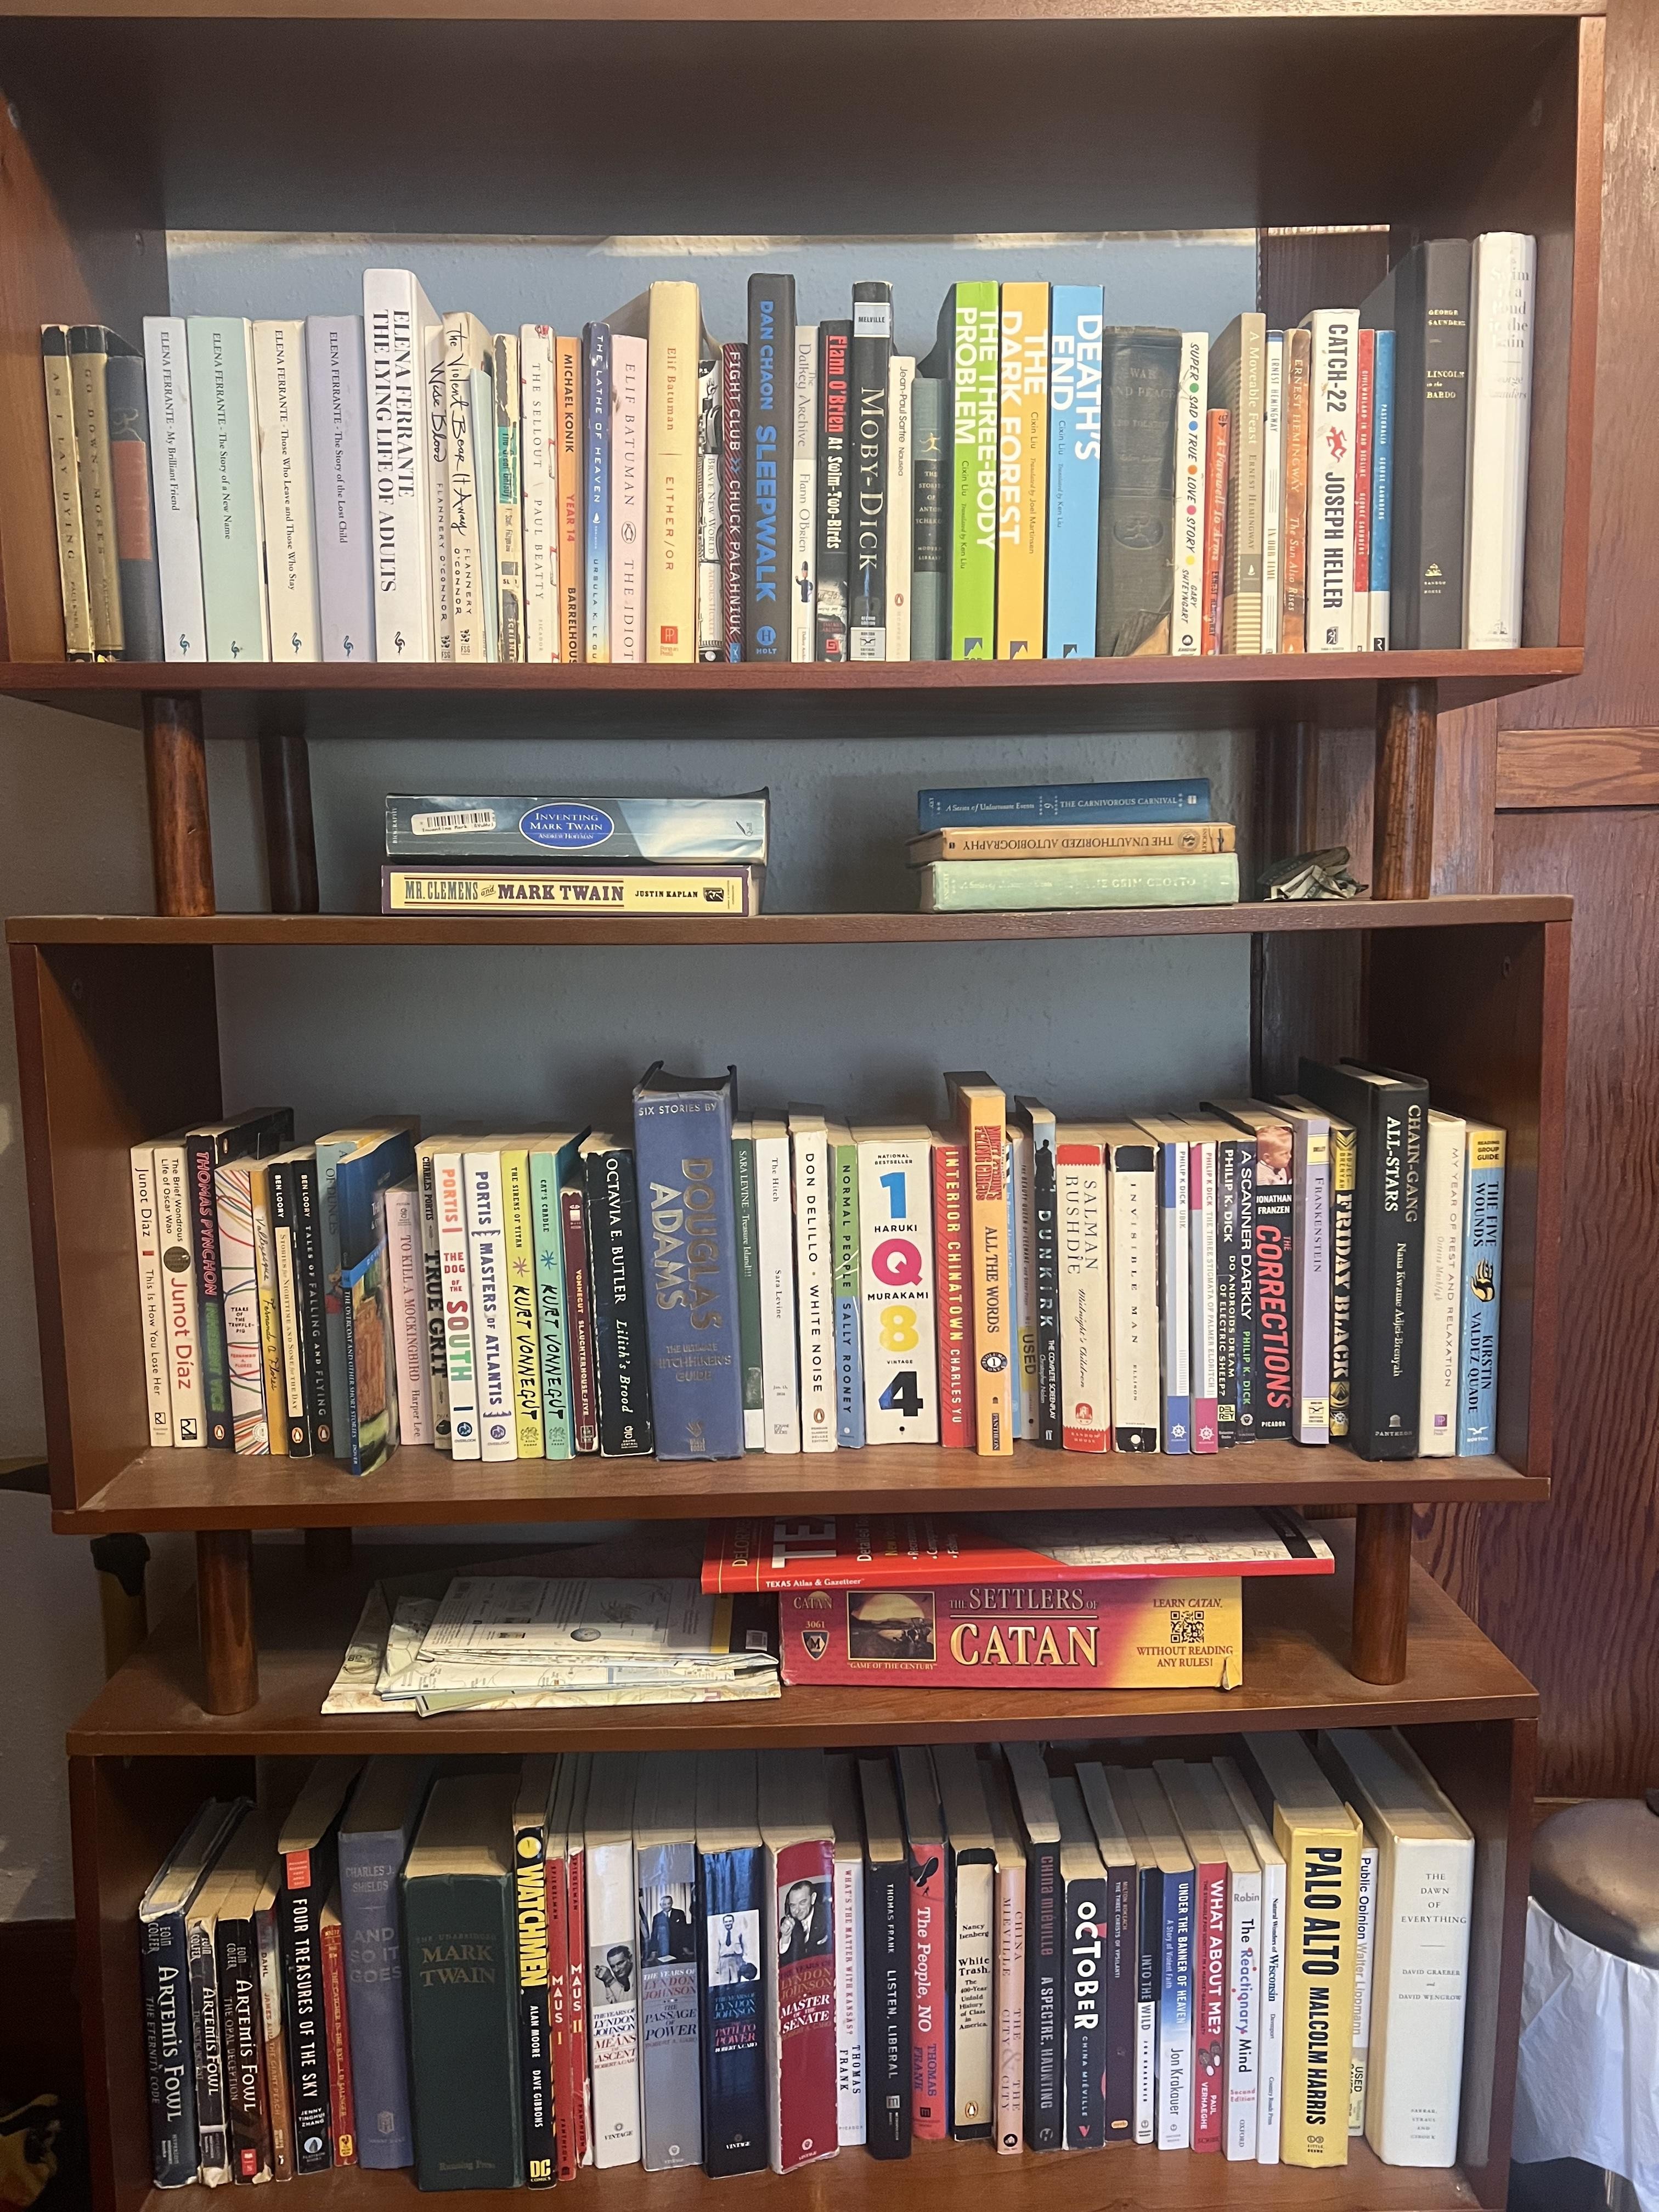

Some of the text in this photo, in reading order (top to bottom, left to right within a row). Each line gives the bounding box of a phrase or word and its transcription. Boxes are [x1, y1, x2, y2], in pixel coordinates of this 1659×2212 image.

[858, 315, 885, 324] MELVILLE
[828, 335, 848, 432] Flann O'Brien
[899, 366, 907, 413] Jean-Paul
[955, 307, 977, 444] PROBLEM
[1024, 329, 1048, 395] THE
[1051, 335, 1074, 410] END
[1075, 315, 1103, 460] DEATH'S
[161, 331, 180, 511] ELENA FERRANTE My Brilliant Friend
[394, 311, 414, 498] ELENA FERRANTE
[446, 323, 473, 537] The Violent Bear It Away
[563, 354, 574, 453] MICHAEL KONIK
[595, 423, 601, 439] OF
[899, 414, 907, 443] Sartre
[977, 309, 999, 550] THE THREE-BODY
[999, 311, 1022, 544] DARK FOREST
[373, 309, 396, 592] THE LYING LIFE OF ADULTS
[755, 301, 776, 602] DAN CHAON SLEEPWALK
[1186, 342, 1199, 554] SUPER SAD TRUE LOVE STORY
[1323, 324, 1348, 610] CATCH-22 JOSEPH HELLER
[665, 476, 674, 571] EITHER/OR
[729, 351, 741, 635] FIGHT CLUB CHUCK PALAHNIUK
[530, 822, 602, 831] MARK TWAIN
[535, 812, 598, 821] INVENTING
[963, 837, 1173, 850] THE UNAUTHORIZED AUTOBIOGRAPHY
[405, 881, 425, 900] MR.
[427, 882, 478, 900] CLEMENS
[481, 885, 495, 896] and
[498, 885, 555, 900] MARK
[559, 885, 624, 901] TWAIN
[135, 1168, 148, 1203] Junot
[1385, 1116, 1402, 1212] ALL-STARS
[1405, 1105, 1420, 1223] CHAIN-GANG
[142, 1208, 152, 1237] Díaz
[196, 1152, 216, 1296] THOMAS PYNCHON
[606, 1158, 627, 1304] OCTAVIA E. BUTLER
[874, 1224, 917, 1233] HARUKI
[1241, 1150, 1252, 1320] A SCANNER DARKLY
[1258, 1206, 1290, 1214] FRANZEN
[1283, 1235, 1291, 1251] THE
[1472, 1183, 1486, 1248] WOUNDS
[1486, 1181, 1499, 1247] THE FIVE
[650, 1183, 683, 1311] ADAMS
[681, 1159, 722, 1330] DOUGLAS
[805, 1153, 822, 1393] DON DELILLO WHITE NOISE
[945, 1151, 963, 1341] INTERIOR CHINATOWN
[145, 1269, 155, 1290] This
[148, 1294, 154, 1302] Is
[475, 1171, 502, 1404] PORTIS MASTERS OF ATLANTIS
[867, 1292, 928, 1300] MURAKAMI
[148, 1305, 157, 1327] How
[149, 1329, 157, 1348] You
[1256, 1224, 1290, 1408] CORRECTIONS
[150, 1352, 159, 1374] Lose
[513, 1286, 540, 1420] KURT VONNEGUT
[793, 1597, 832, 1610] CATAN
[805, 1621, 826, 1629] 3061
[950, 1589, 1084, 1611] THE SETTLERS
[1153, 1599, 1186, 1609] LEARN
[950, 1624, 1098, 1668] CATAN
[1137, 1645, 1233, 1656] WITHOUT READING
[1157, 1657, 1214, 1667] ANY RULES!
[292, 1899, 308, 1933] FOUR
[516, 1863, 547, 1987] WATCHMEN
[295, 1939, 312, 2015] TREASURES
[571, 1964, 582, 2012] MAUS
[917, 1908, 932, 2033] The People, NO
[1073, 1901, 1101, 2029] OCTOBER
[1207, 1880, 1225, 2035] WHAT ABOUT ME?
[1302, 1847, 1342, 2125] PALO ALTO MALCOLM HARRIS
[552, 1976, 565, 2023] MAUS
[573, 2019, 582, 2033] II
[1238, 1918, 1254, 2073] The Reactionary Mind
[298, 2021, 313, 2039] OF
[300, 2044, 315, 2070] THE
[302, 2074, 318, 2099] SKY
